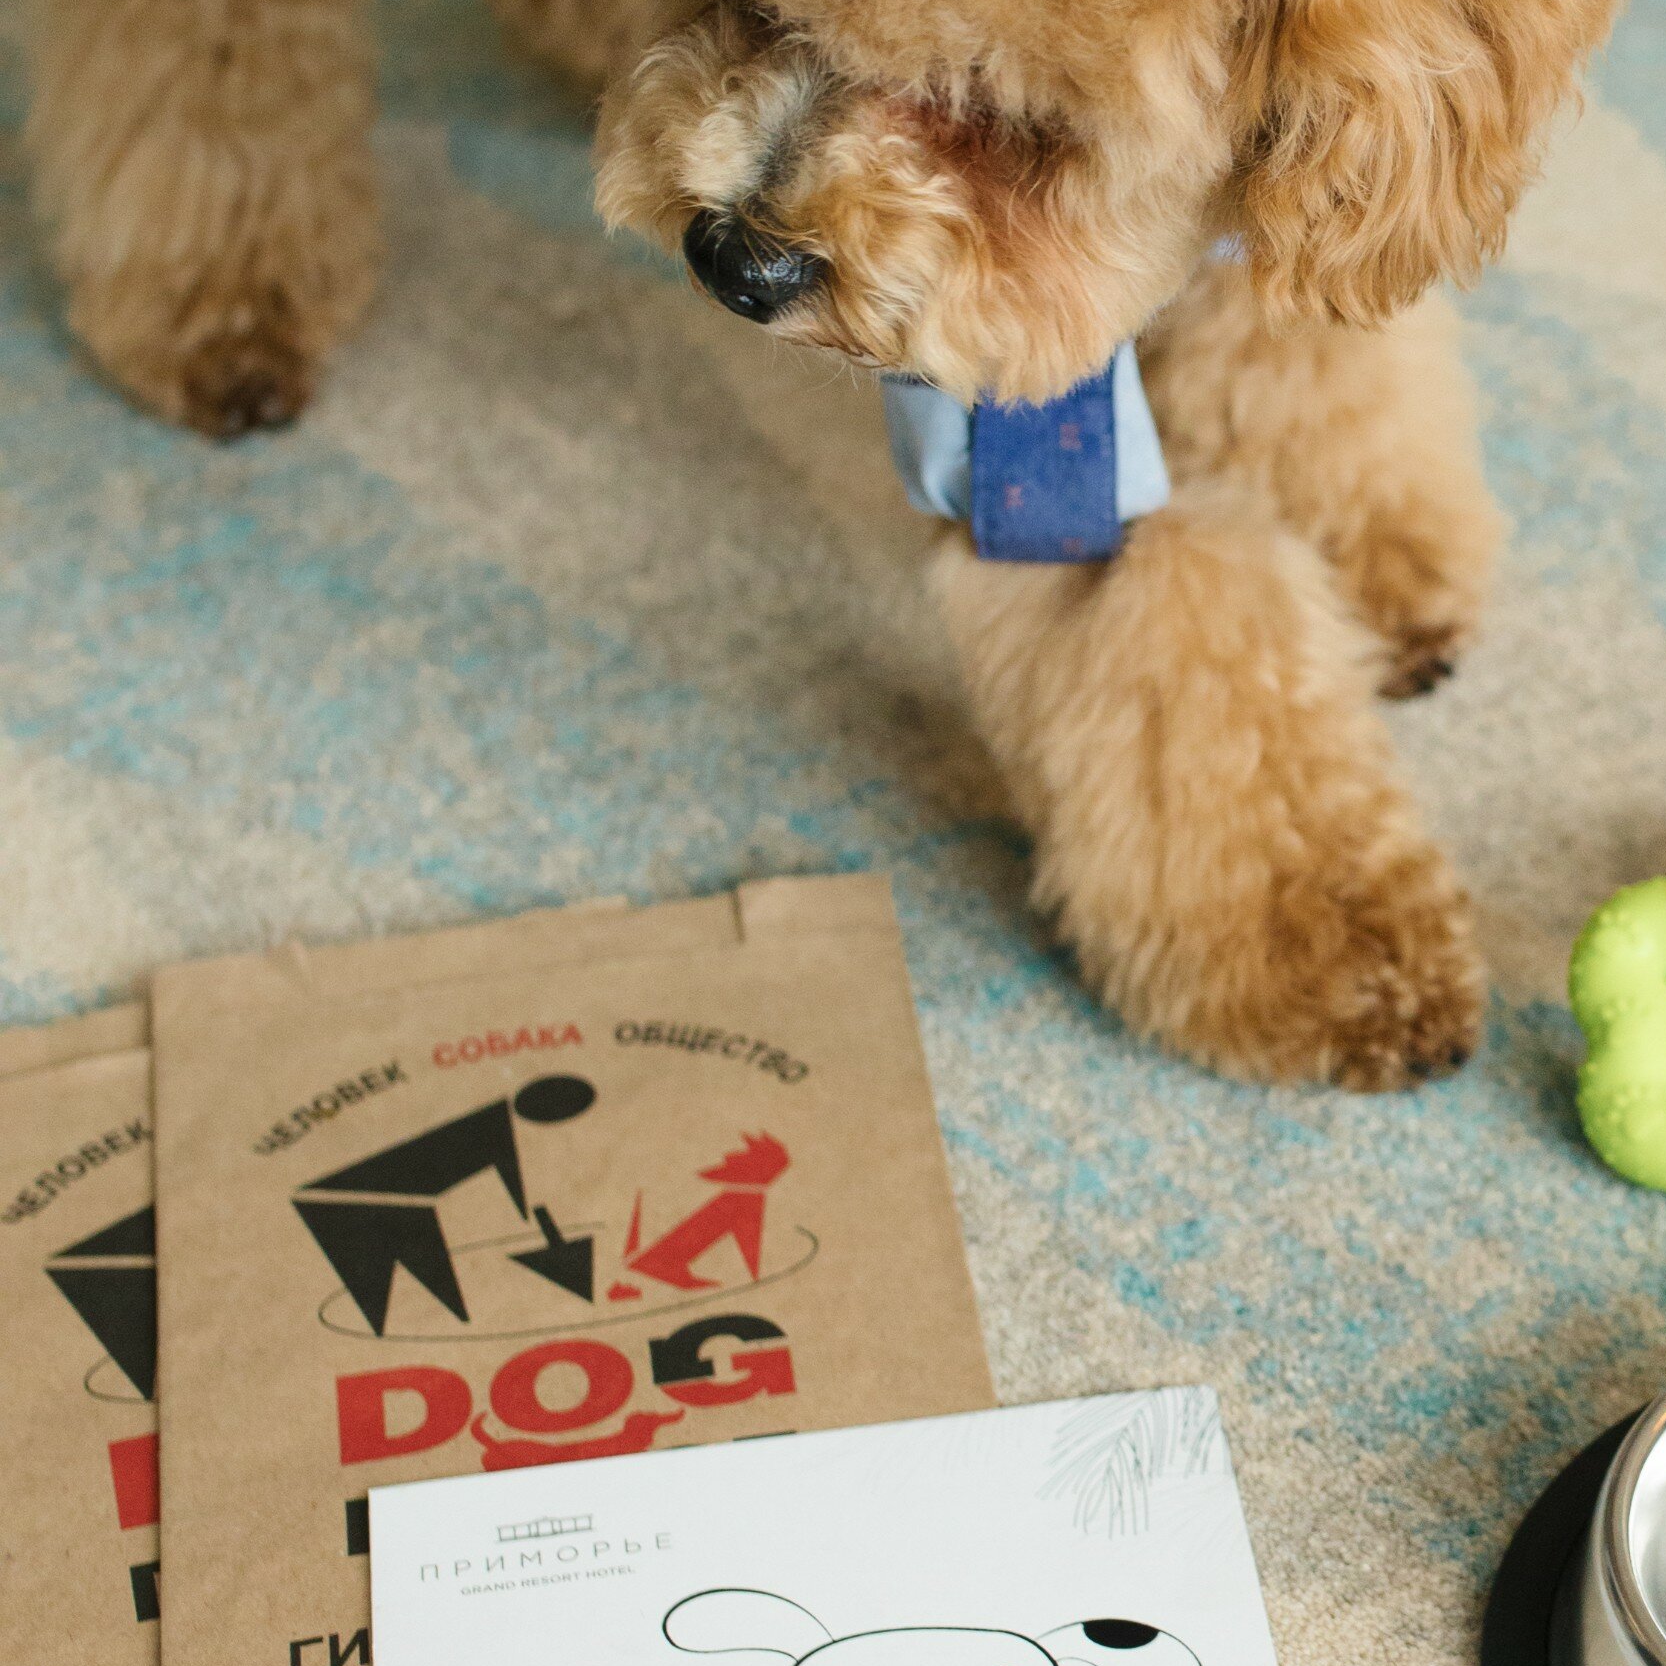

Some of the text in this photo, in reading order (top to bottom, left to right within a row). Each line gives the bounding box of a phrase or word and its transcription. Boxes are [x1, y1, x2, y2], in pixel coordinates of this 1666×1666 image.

[431, 1020, 583, 1070] СОБАКА
[614, 1019, 810, 1085] ОБЩЕСТВО
[335, 1313, 797, 1467] DOG
[420, 1531, 674, 1583] ПРИМОРЬЕ
[459, 1565, 636, 1596] GRAND RESORT HOTEL
